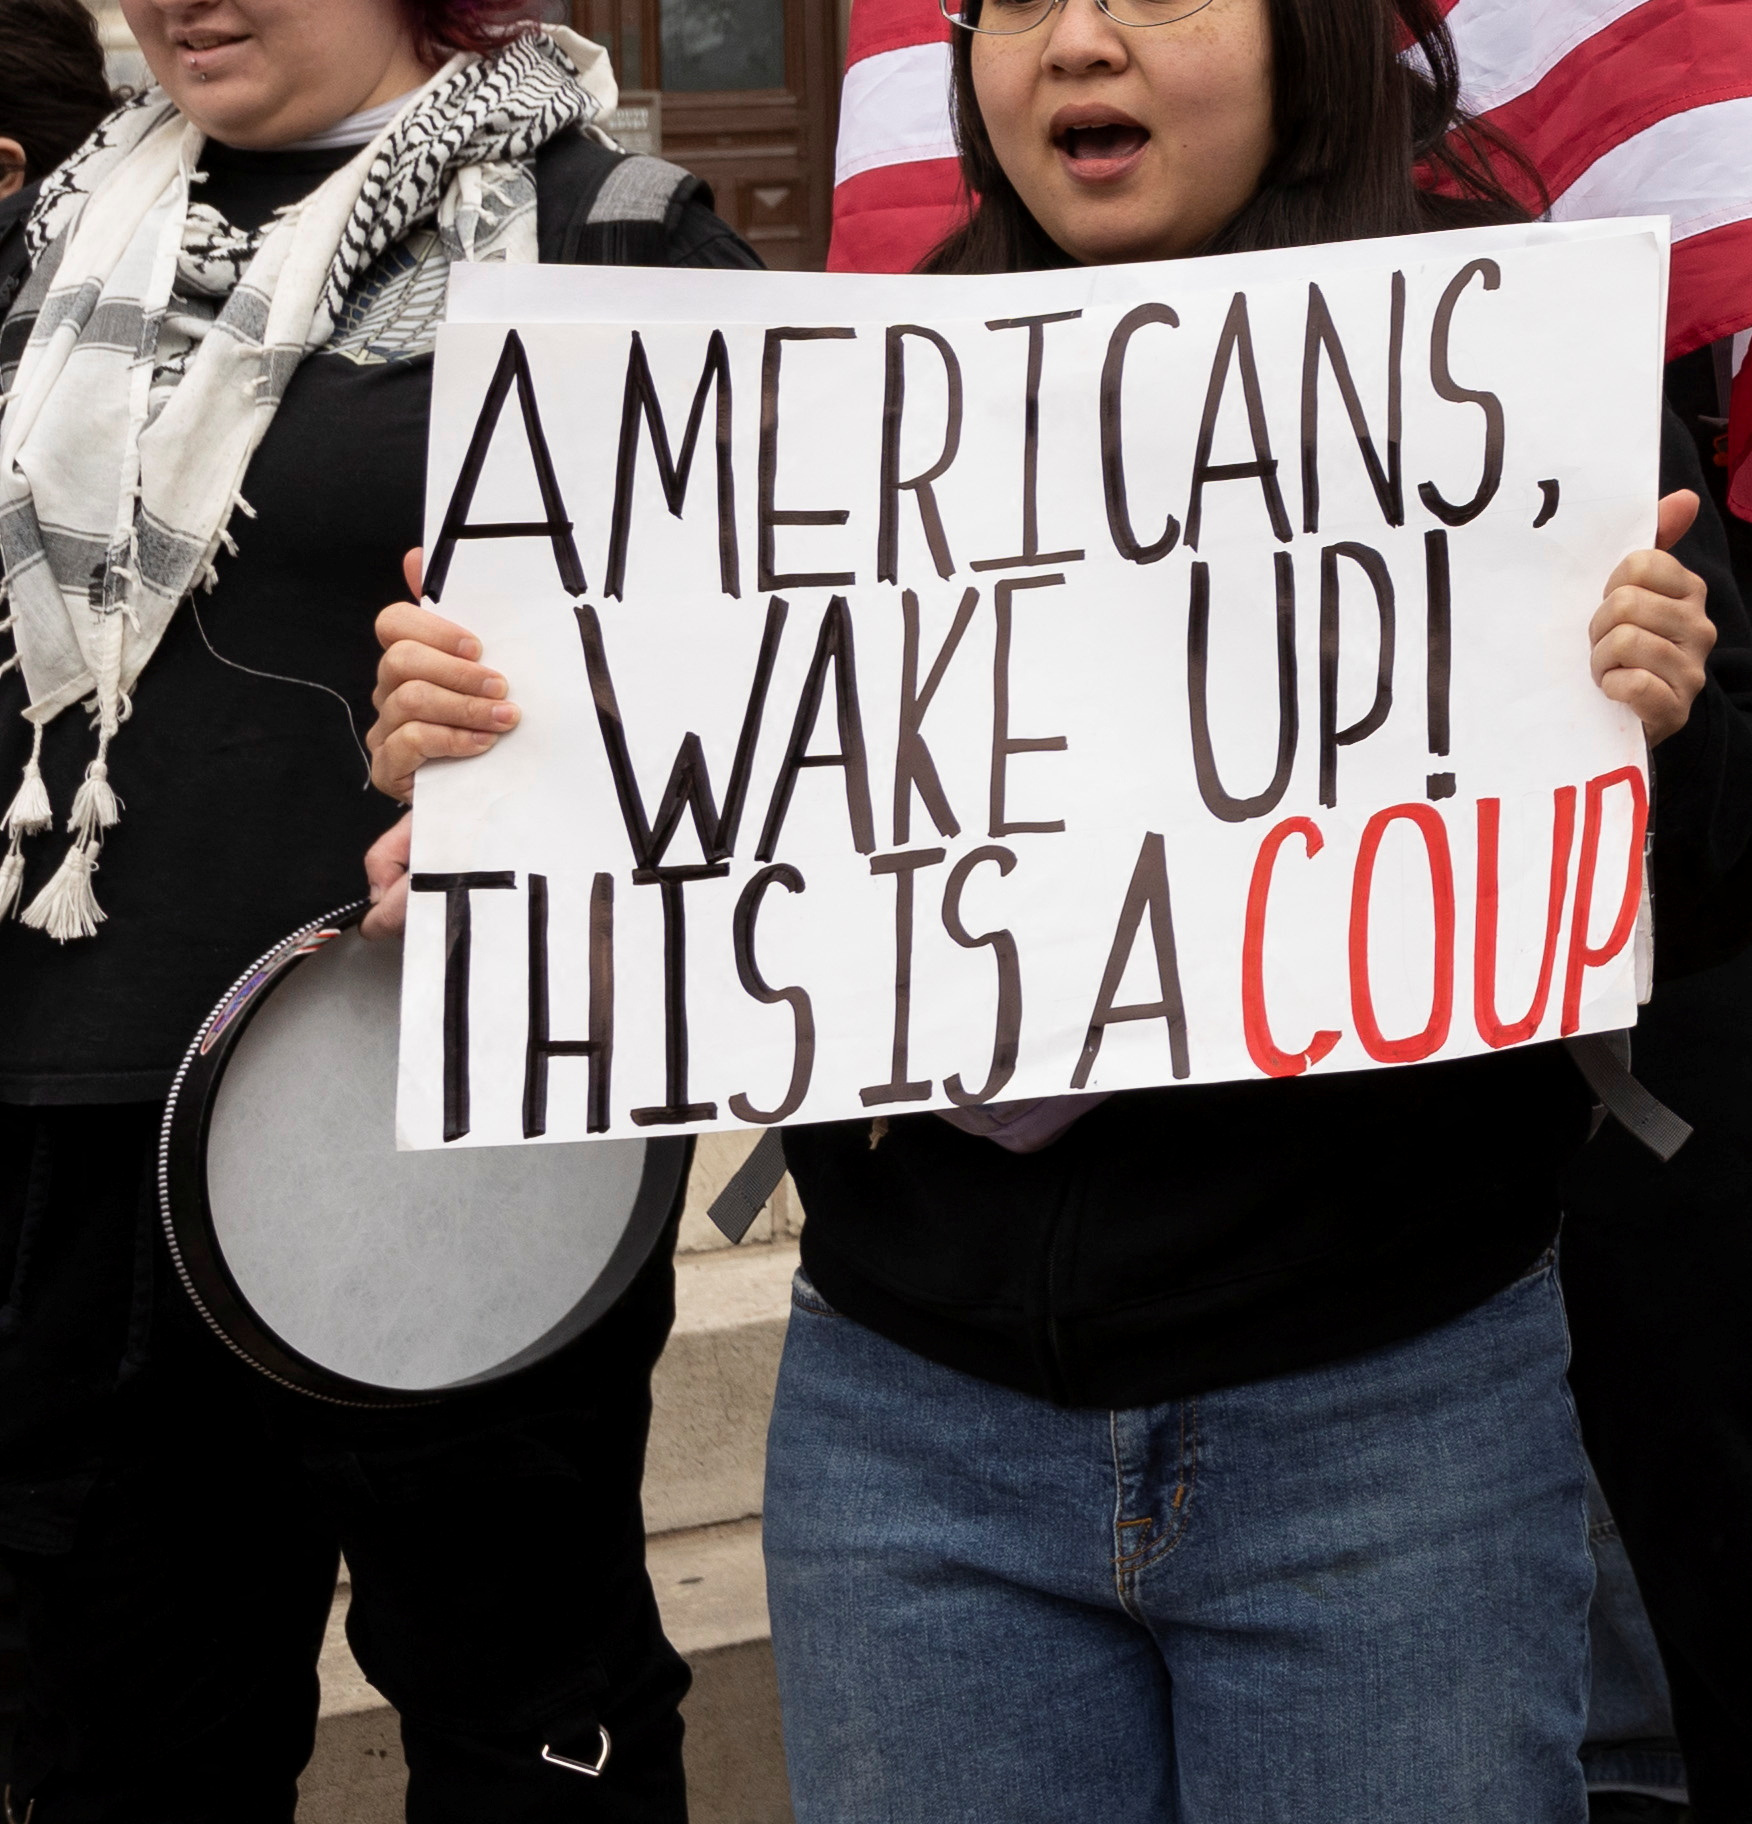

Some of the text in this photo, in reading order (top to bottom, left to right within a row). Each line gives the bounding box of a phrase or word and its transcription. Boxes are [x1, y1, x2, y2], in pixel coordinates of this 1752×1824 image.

[423, 258, 1561, 597] AMERICANS,
[574, 529, 1455, 870] WAKE UP!
[411, 862, 814, 1141] THIS
[860, 845, 1023, 1108] IS
[1071, 831, 1190, 1090] A
[1241, 764, 1648, 1077] COUP
